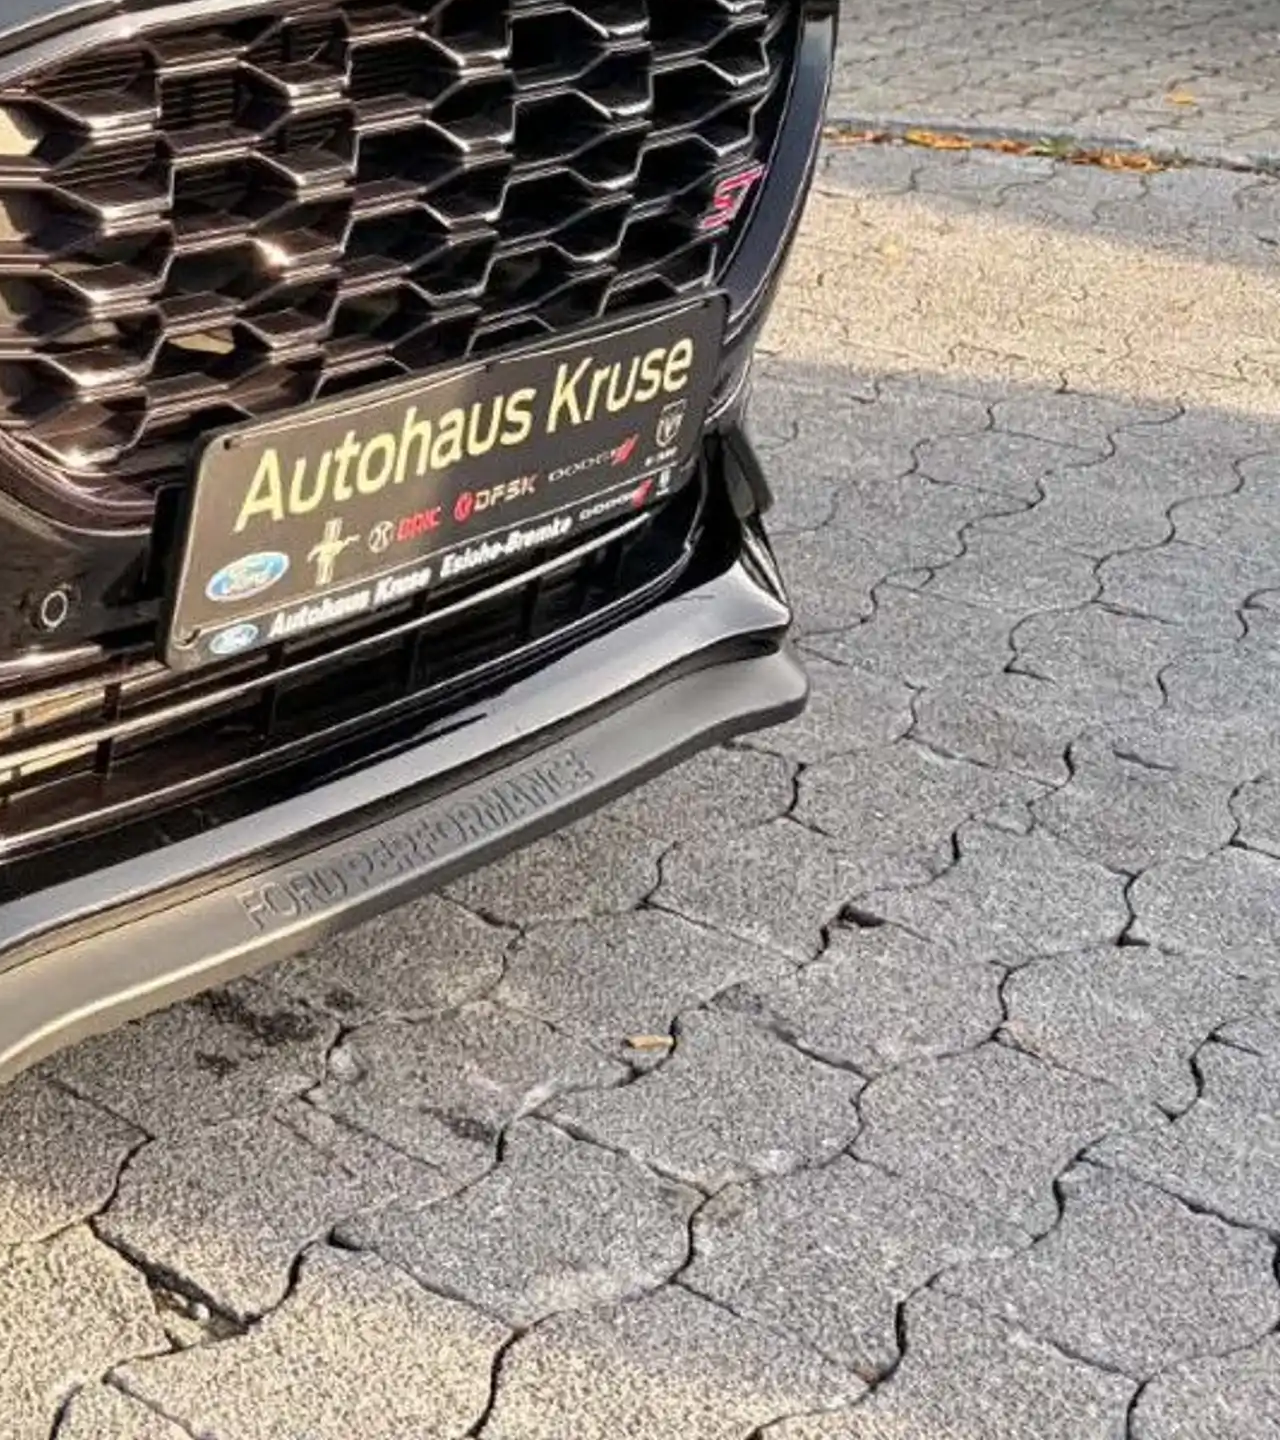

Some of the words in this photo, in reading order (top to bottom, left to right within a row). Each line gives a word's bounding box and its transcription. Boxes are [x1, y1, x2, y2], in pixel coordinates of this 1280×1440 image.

[234, 385, 537, 534] Autohaus
[545, 337, 694, 434] Kruse
[267, 589, 370, 638] Autohaus
[372, 567, 432, 607] Kruse
